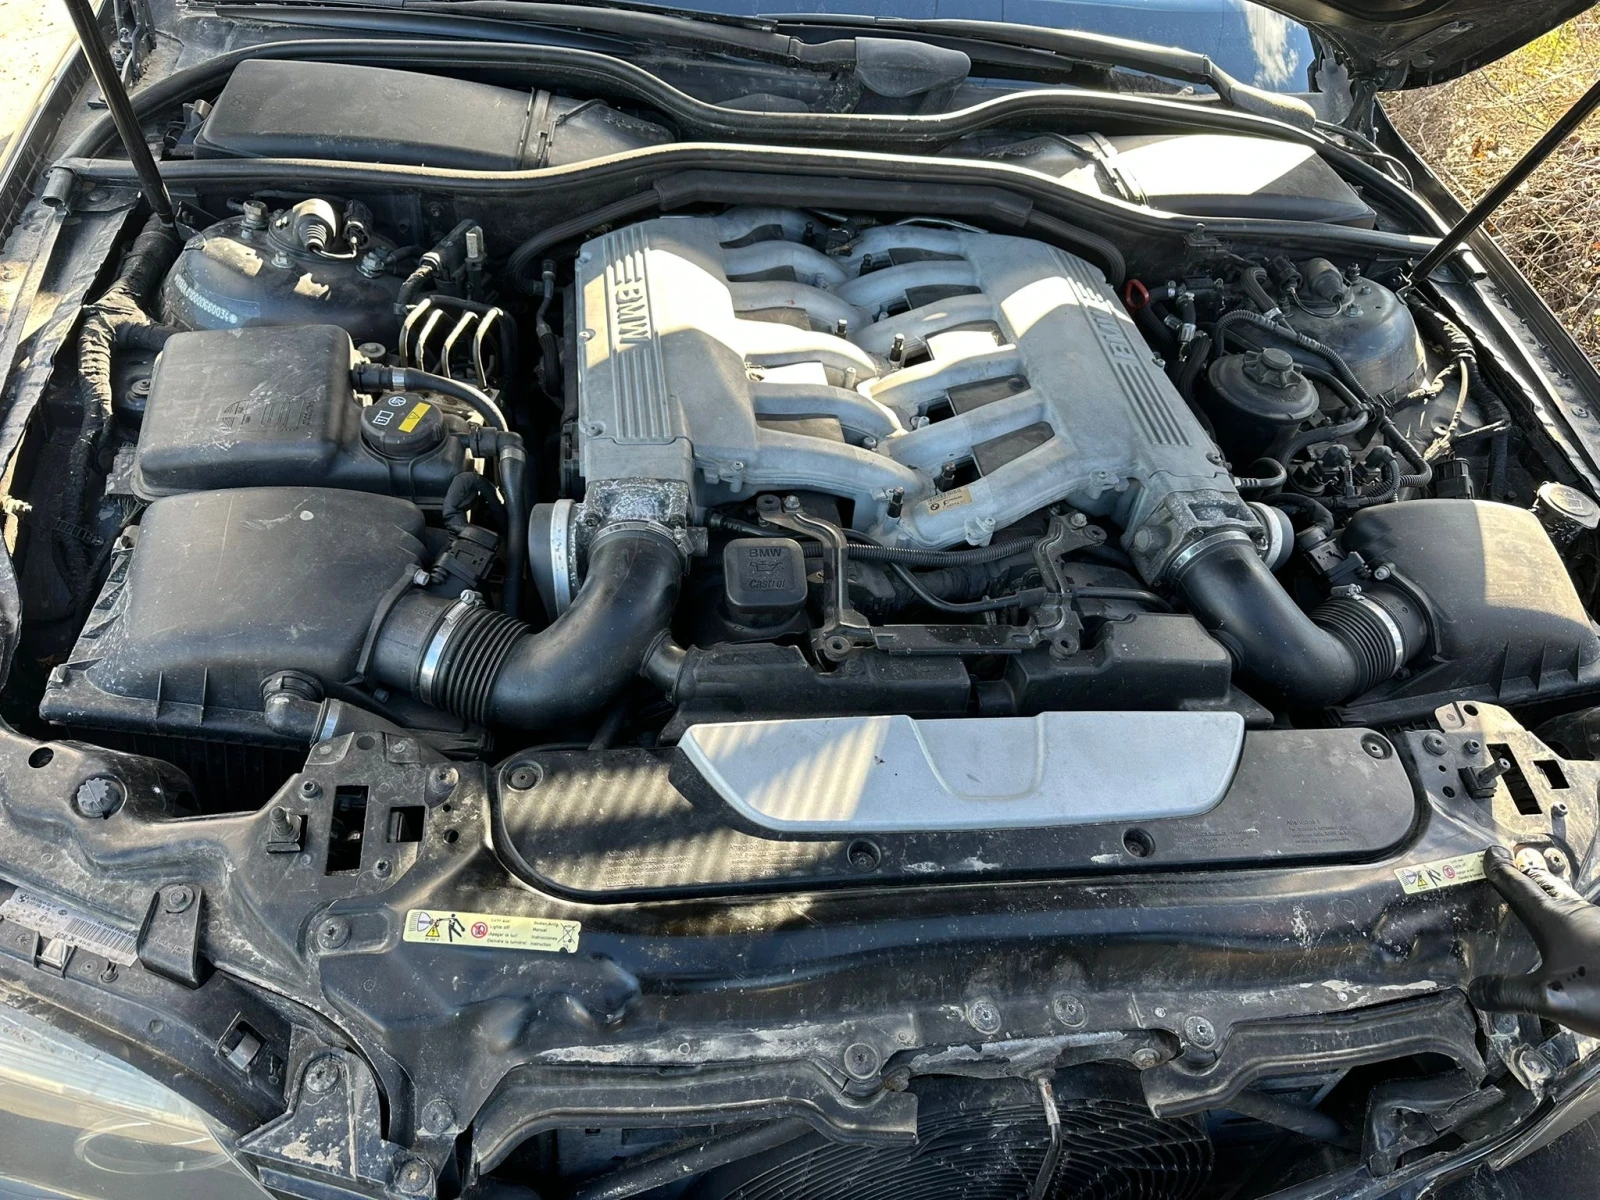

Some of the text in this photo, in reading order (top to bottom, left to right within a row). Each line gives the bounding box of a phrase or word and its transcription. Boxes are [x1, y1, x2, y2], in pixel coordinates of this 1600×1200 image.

[615, 284, 651, 344] BMW
[749, 548, 782, 558] BMW
[749, 579, 786, 589] Castrol
